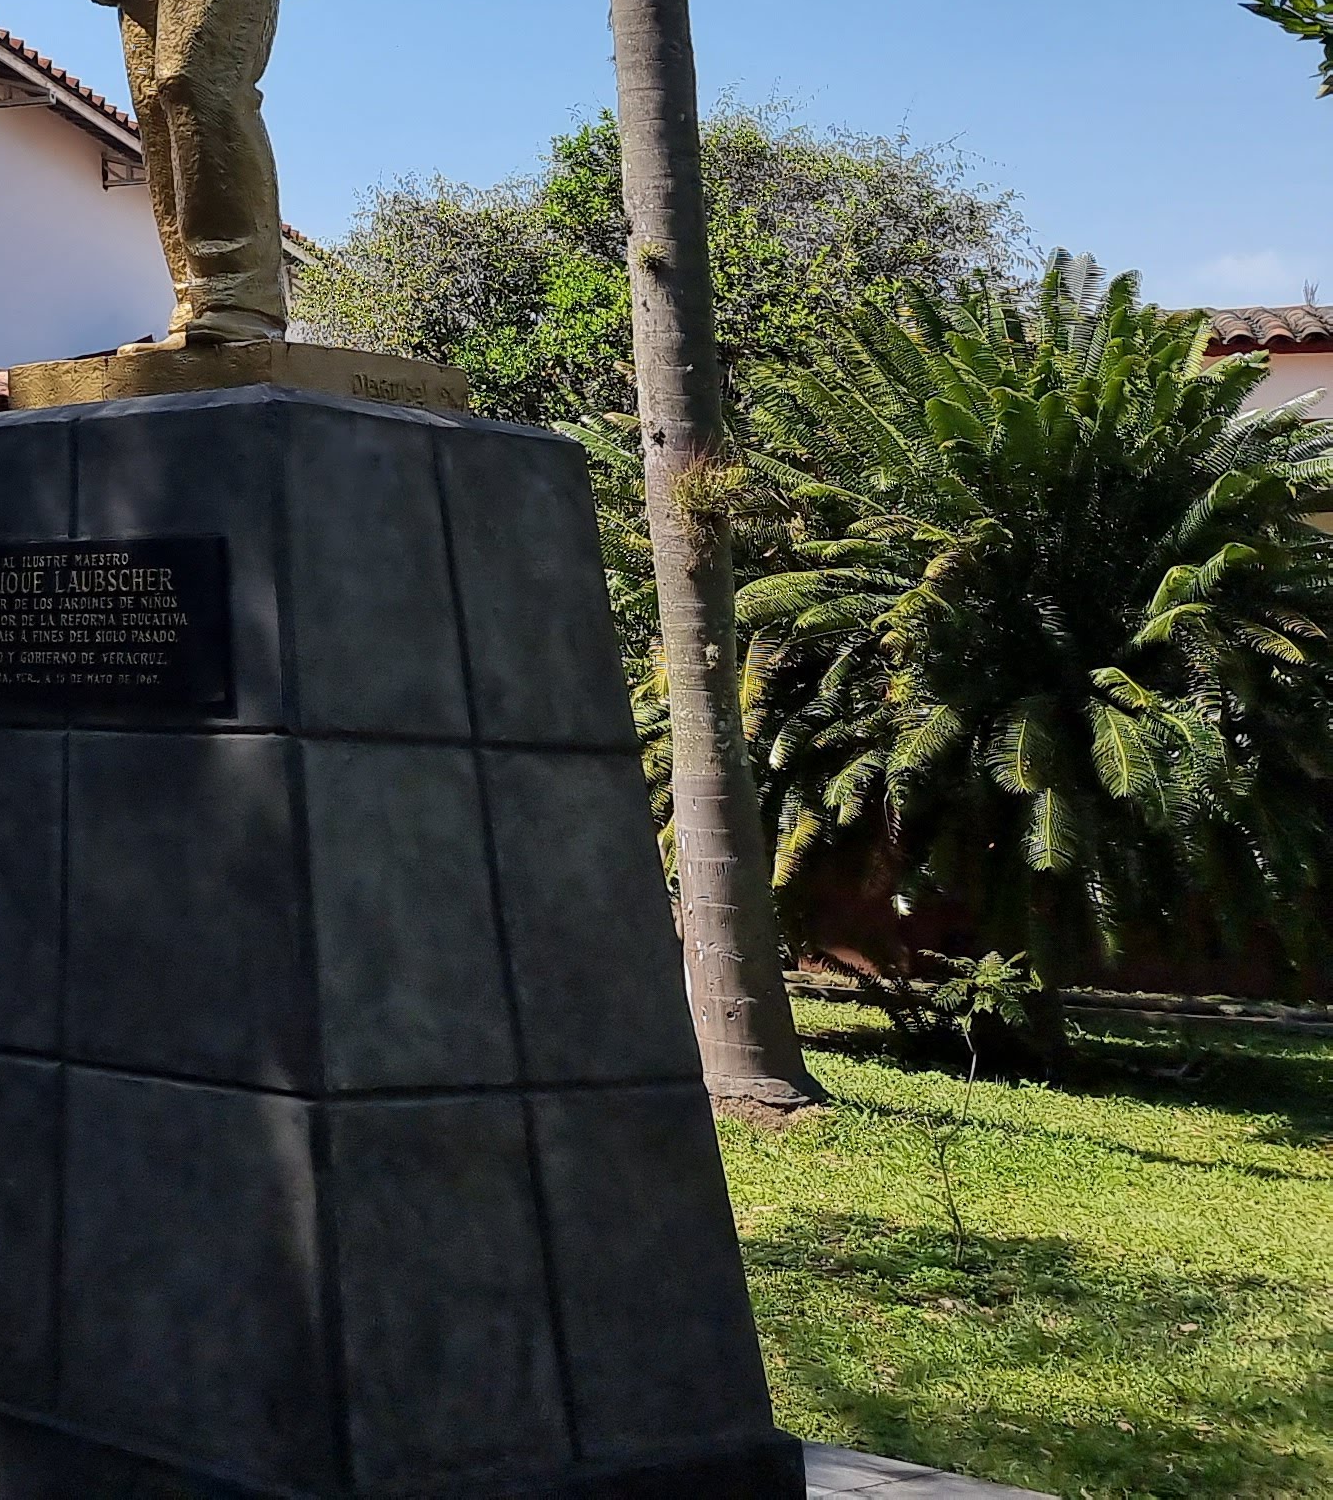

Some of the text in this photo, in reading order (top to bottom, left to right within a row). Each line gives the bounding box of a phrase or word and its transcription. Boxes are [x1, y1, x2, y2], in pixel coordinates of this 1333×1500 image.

[3, 552, 129, 569] AL ILUSTRE MAESTRO
[54, 567, 174, 594] LAUBSCHER
[14, 598, 29, 610] DE
[33, 597, 54, 610] LOS
[58, 596, 114, 610] JARDINES
[119, 596, 135, 609] DE
[140, 592, 178, 609] NIÑOS
[21, 614, 35, 627] DE
[40, 614, 56, 626] LA
[60, 612, 116, 627] REFORMA
[121, 612, 189, 626] EDUCATIVA
[20, 629, 29, 643] A
[33, 630, 64, 643] FINES
[69, 630, 91, 643] DEL
[95, 630, 127, 643] SIGLO
[7, 651, 15, 664] Y
[20, 651, 77, 665] GOBIERNO
[81, 652, 95, 665] DE
[70, 674, 83, 684] DE
[118, 674, 132, 685] DE
